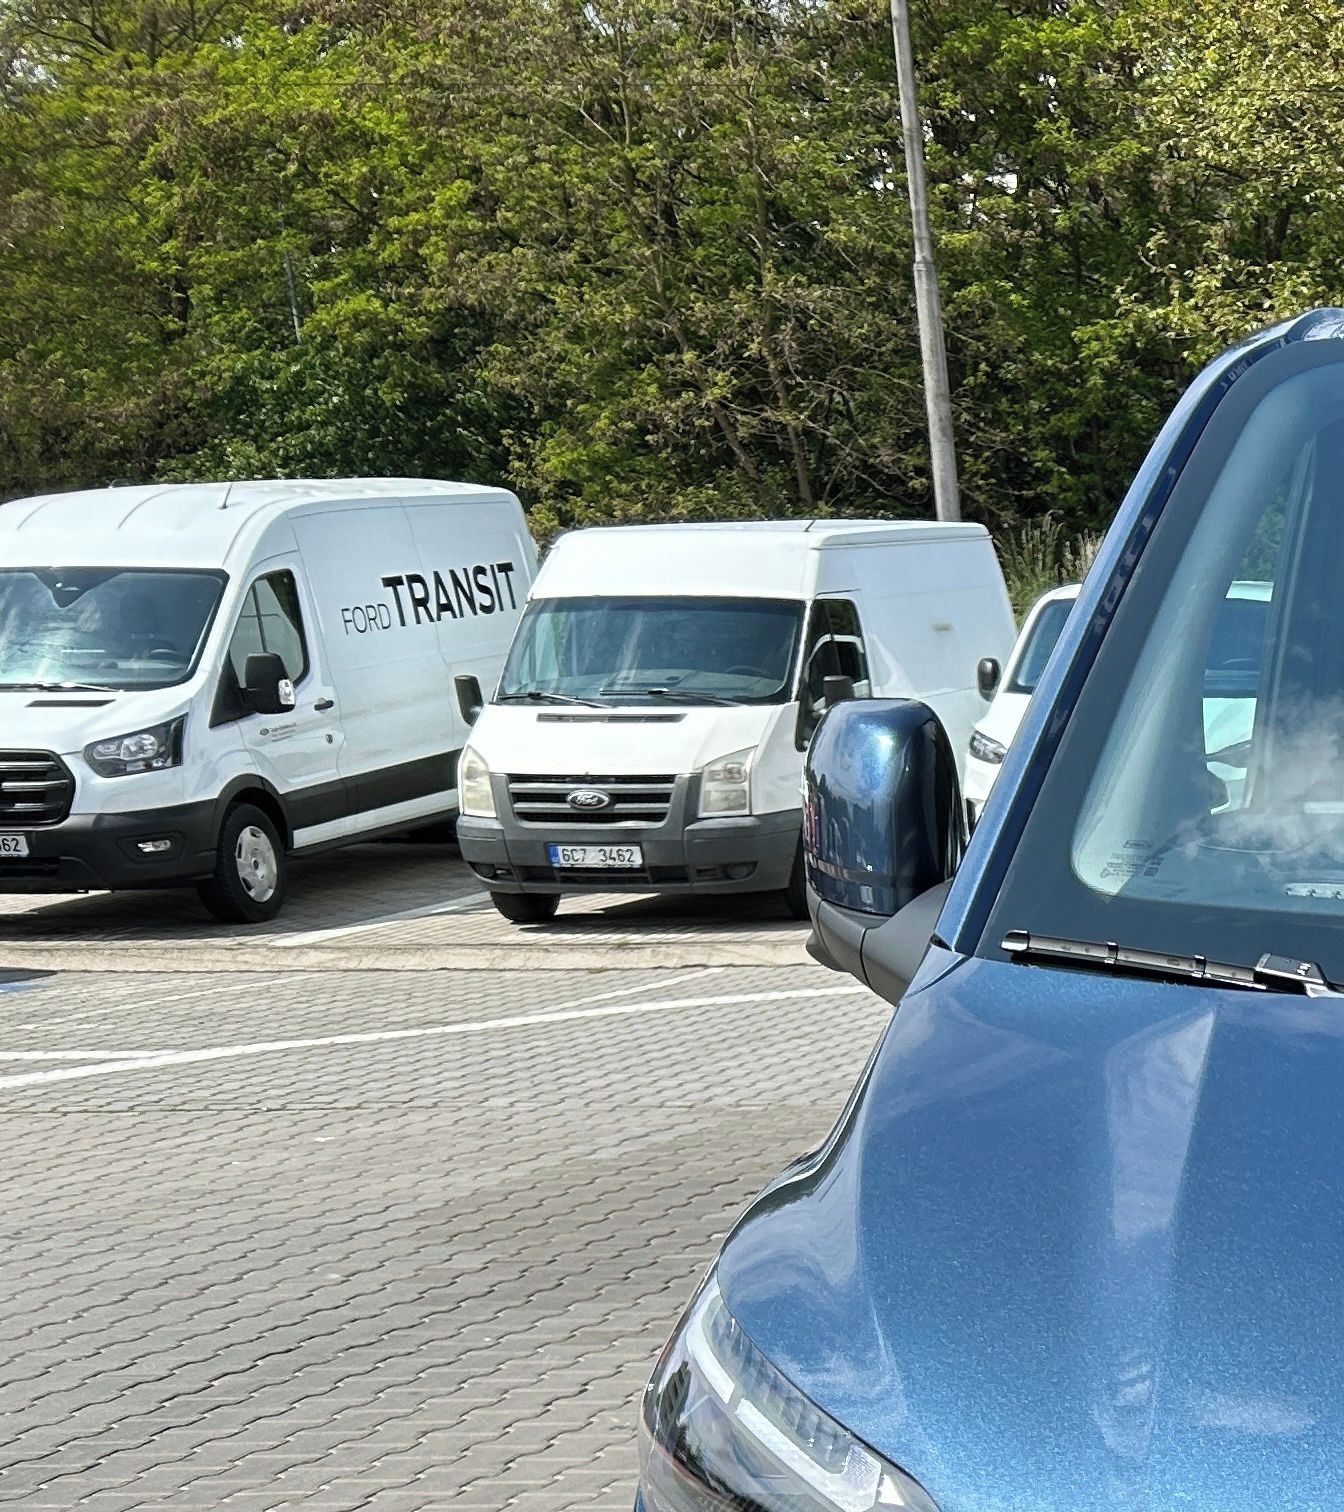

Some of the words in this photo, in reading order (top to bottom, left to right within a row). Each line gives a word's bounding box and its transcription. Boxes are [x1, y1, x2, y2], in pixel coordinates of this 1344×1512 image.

[341, 602, 392, 635] FORD
[380, 561, 517, 627] TRANSIT
[0, 837, 22, 853] 62
[561, 848, 588, 863] 6C7
[598, 847, 635, 863] 3462
